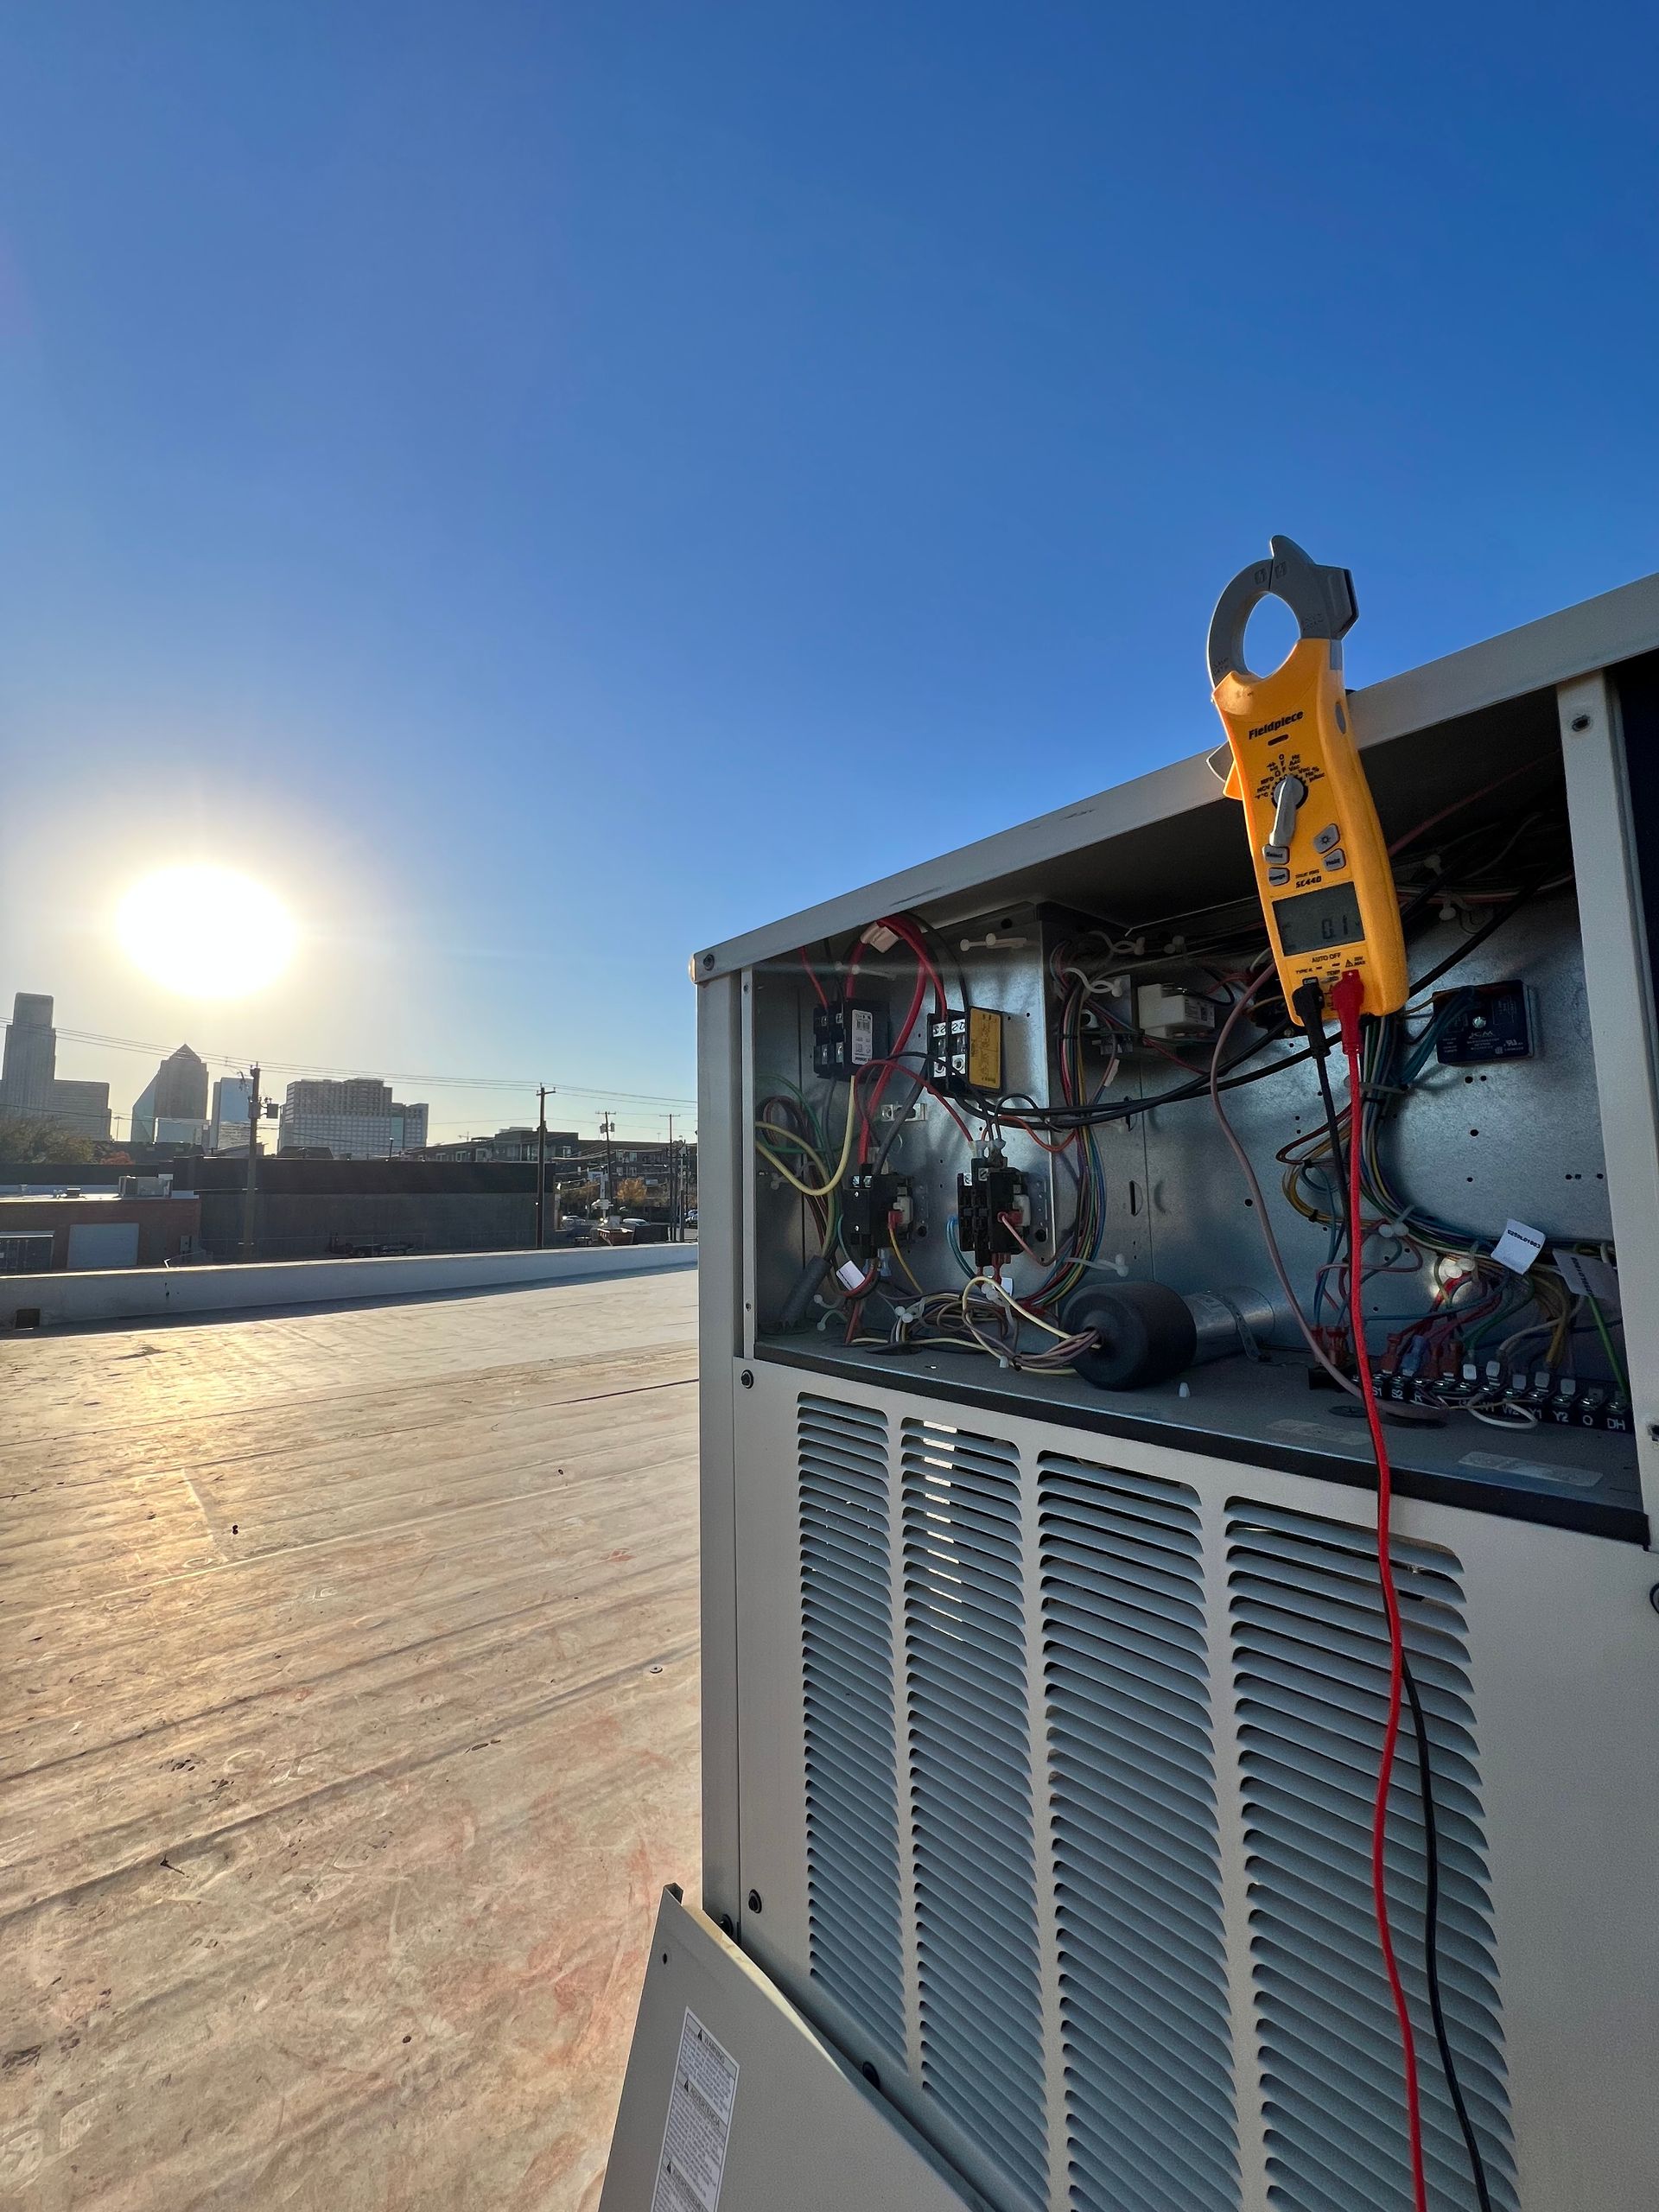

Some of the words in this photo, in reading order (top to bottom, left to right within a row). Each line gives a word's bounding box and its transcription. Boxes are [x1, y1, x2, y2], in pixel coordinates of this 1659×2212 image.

[1248, 711, 1304, 740] Fieldpiece
[1295, 875, 1322, 888] SC440
[1312, 955, 1329, 963] AUTO
[1372, 1385, 1382, 1397] S1
[1391, 1389, 1404, 1400] S2
[1529, 1408, 1542, 1420] Y1
[1553, 1410, 1569, 1422] Y2
[1606, 1417, 1626, 1431] DH
